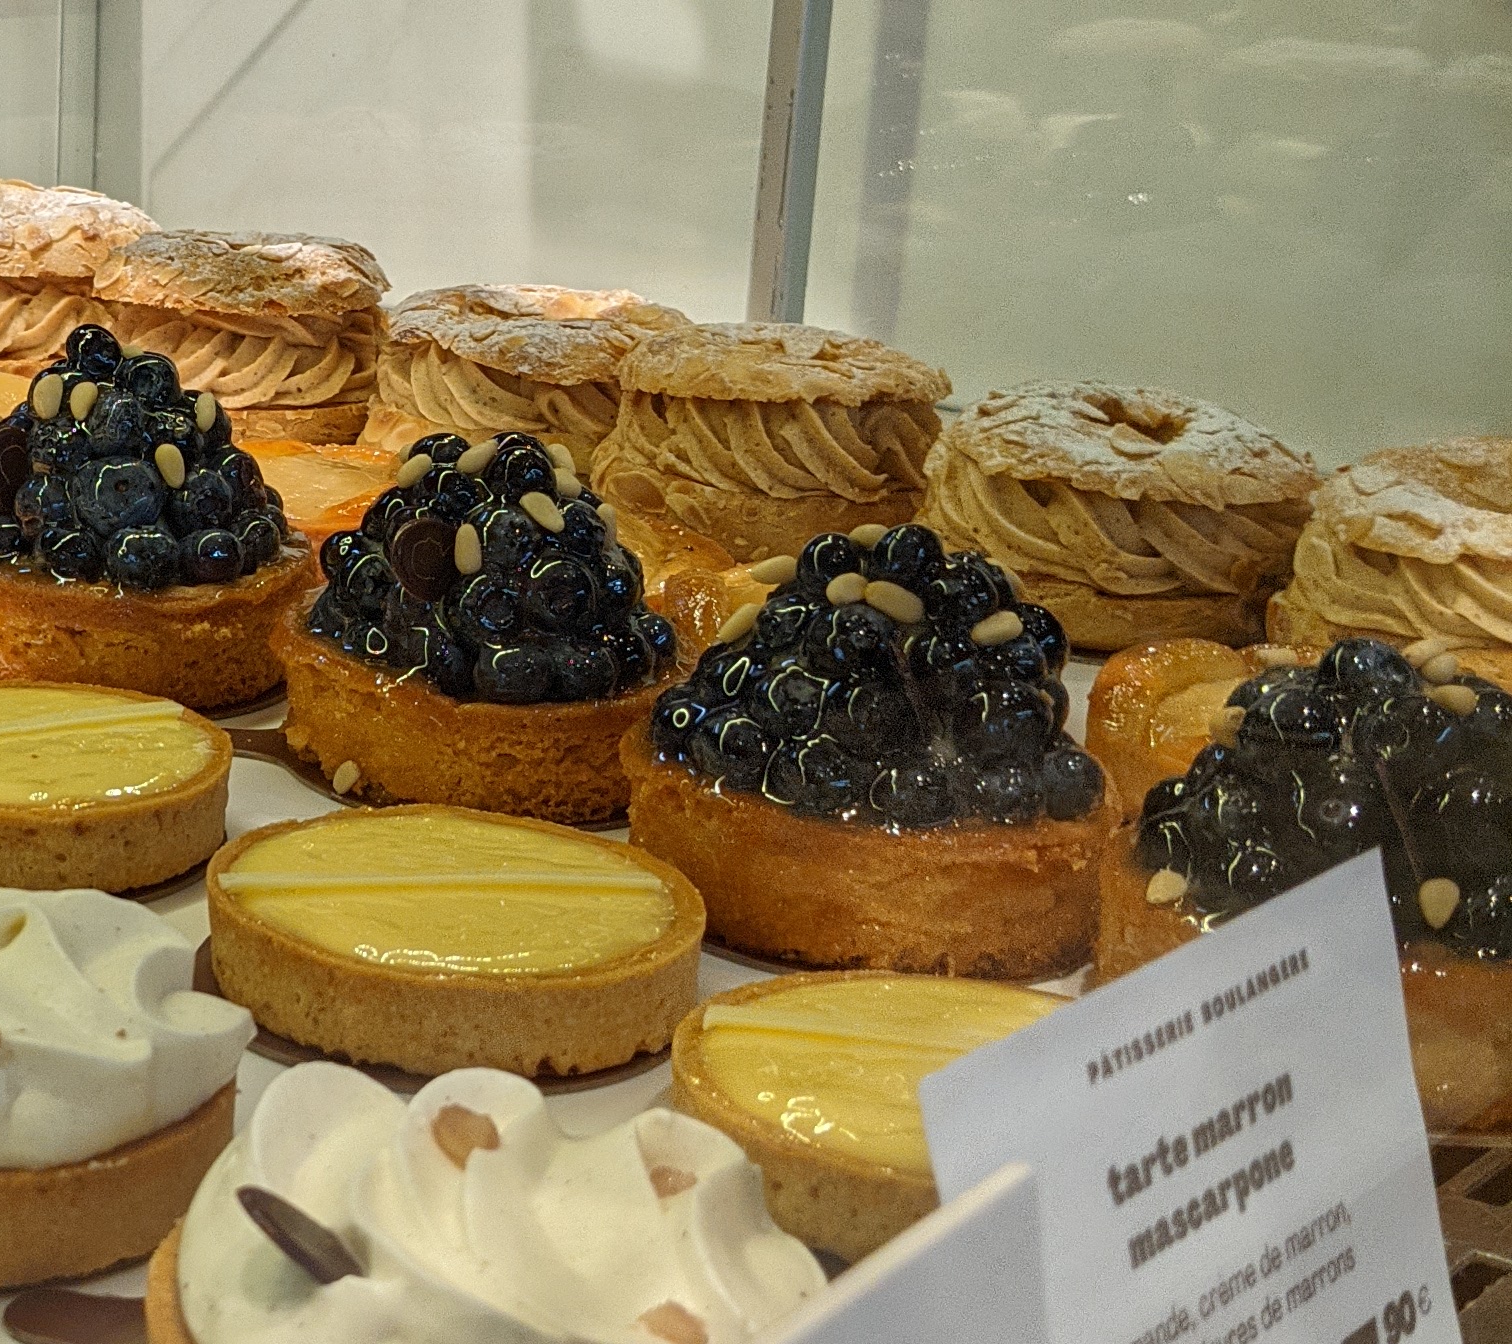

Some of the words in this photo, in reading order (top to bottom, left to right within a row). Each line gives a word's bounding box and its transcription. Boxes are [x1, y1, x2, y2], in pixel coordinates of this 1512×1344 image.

[1107, 1135, 1189, 1206] tarte
[1192, 1072, 1294, 1157] marron
[1128, 1139, 1295, 1270] mascarpone
[1259, 1243, 1282, 1279] de
[1260, 1293, 1284, 1330] de
[1286, 1247, 1357, 1314] marrons
